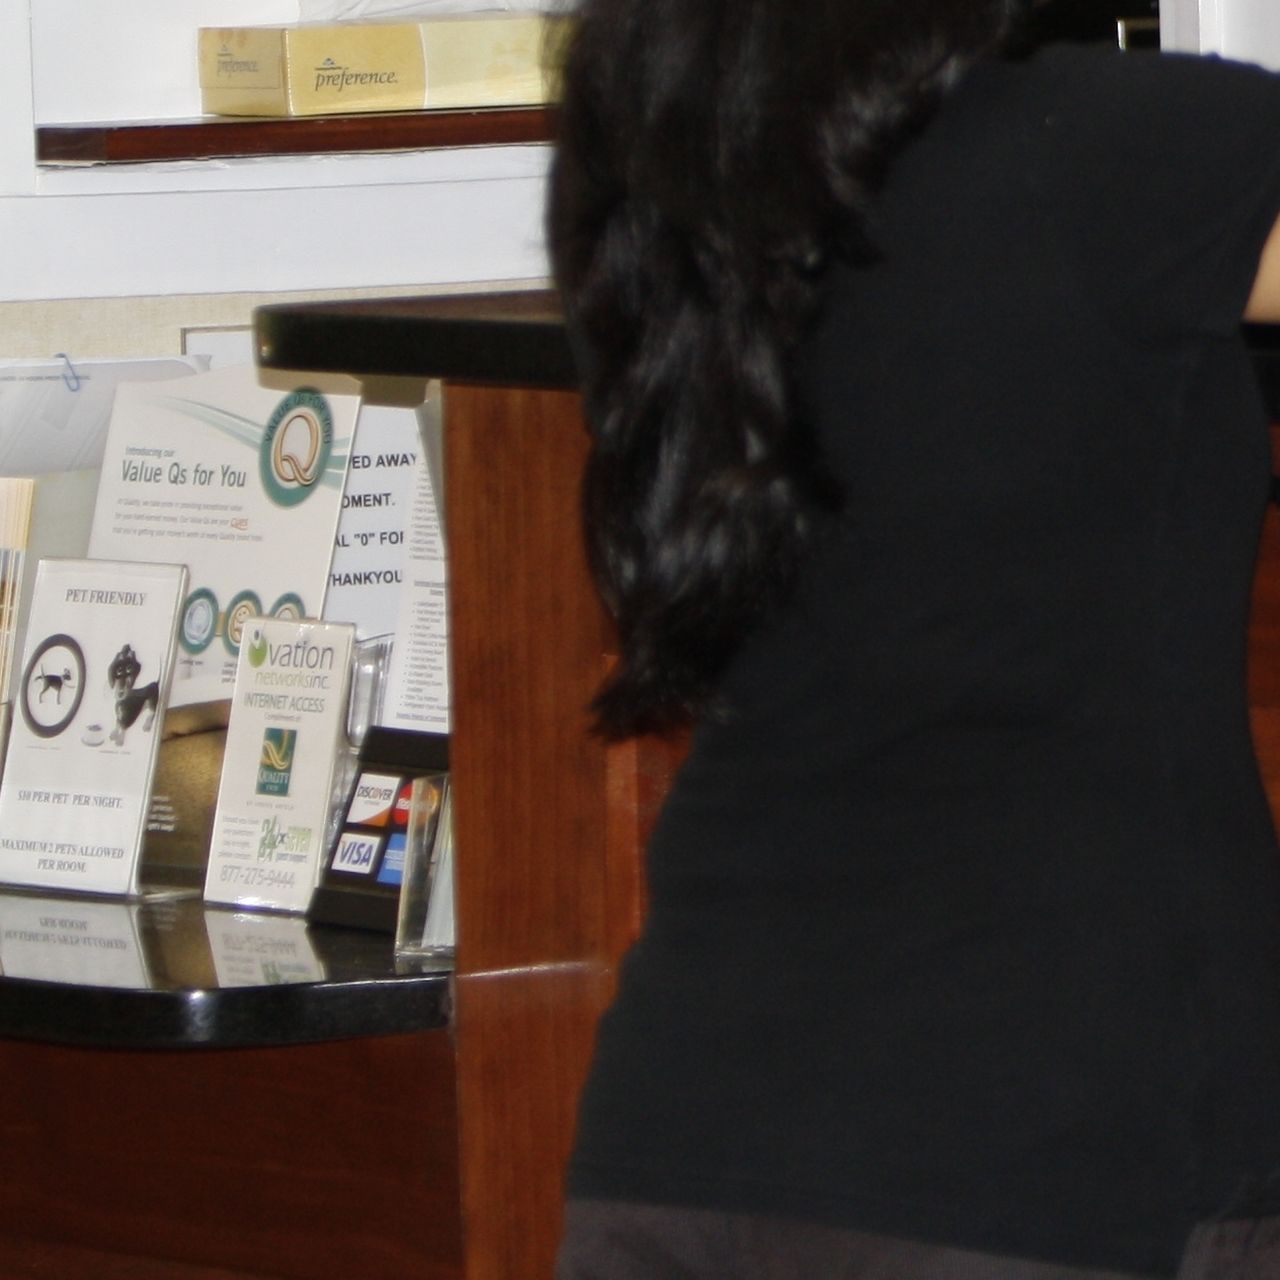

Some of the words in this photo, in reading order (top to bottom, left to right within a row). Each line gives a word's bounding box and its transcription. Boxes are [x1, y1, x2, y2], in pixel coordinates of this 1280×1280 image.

[375, 453, 417, 468] AWAY
[122, 459, 162, 484] Value
[168, 462, 188, 486] Qs
[193, 464, 214, 486] for
[220, 464, 248, 488] You
[65, 588, 88, 603] PET
[89, 589, 147, 607] FRIENDLY
[245, 692, 289, 709] INTERNET
[288, 696, 325, 713] ACCESS
[258, 770, 290, 785] QUALITY
[32, 791, 51, 802] PER
[52, 793, 70, 805] PET
[72, 794, 90, 806] PER
[357, 786, 393, 801] DISCOVER
[1, 839, 47, 853] MAXIMUM
[48, 842, 53, 853] 2
[54, 843, 77, 856] PETS
[79, 846, 125, 859] ALLOWED
[340, 841, 373, 867] VISA
[37, 859, 54, 870] PER
